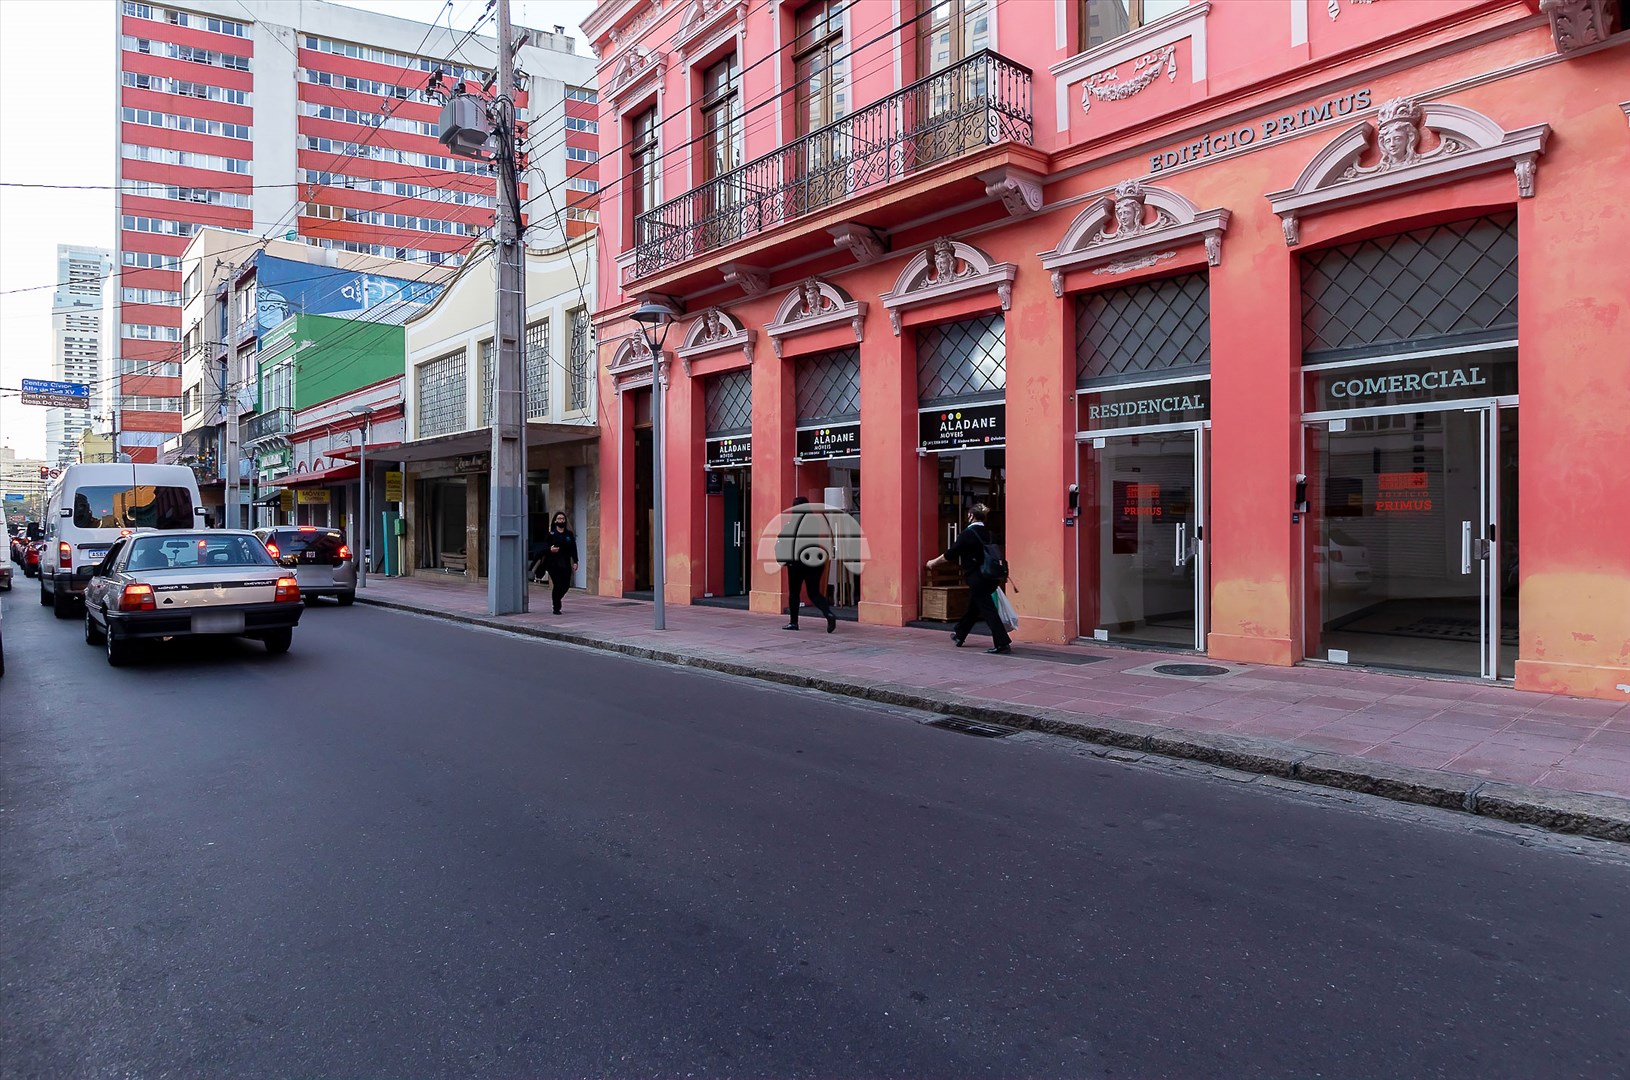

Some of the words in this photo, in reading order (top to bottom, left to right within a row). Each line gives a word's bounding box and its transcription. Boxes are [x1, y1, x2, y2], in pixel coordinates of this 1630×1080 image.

[1149, 127, 1255, 173] EDIFÍCIO
[1261, 88, 1372, 140] PRIMUS
[23, 379, 48, 387] Centro
[1330, 367, 1486, 398] COMERCIAL
[1089, 394, 1205, 420] RESIDENCIAL
[940, 417, 996, 431] ALADANE
[813, 432, 855, 445] ALADANE
[939, 431, 964, 439] MÓVEIS
[719, 442, 751, 454] ALADANE
[1375, 499, 1432, 511] PRIMUS
[1123, 507, 1163, 516] PRIMUS
